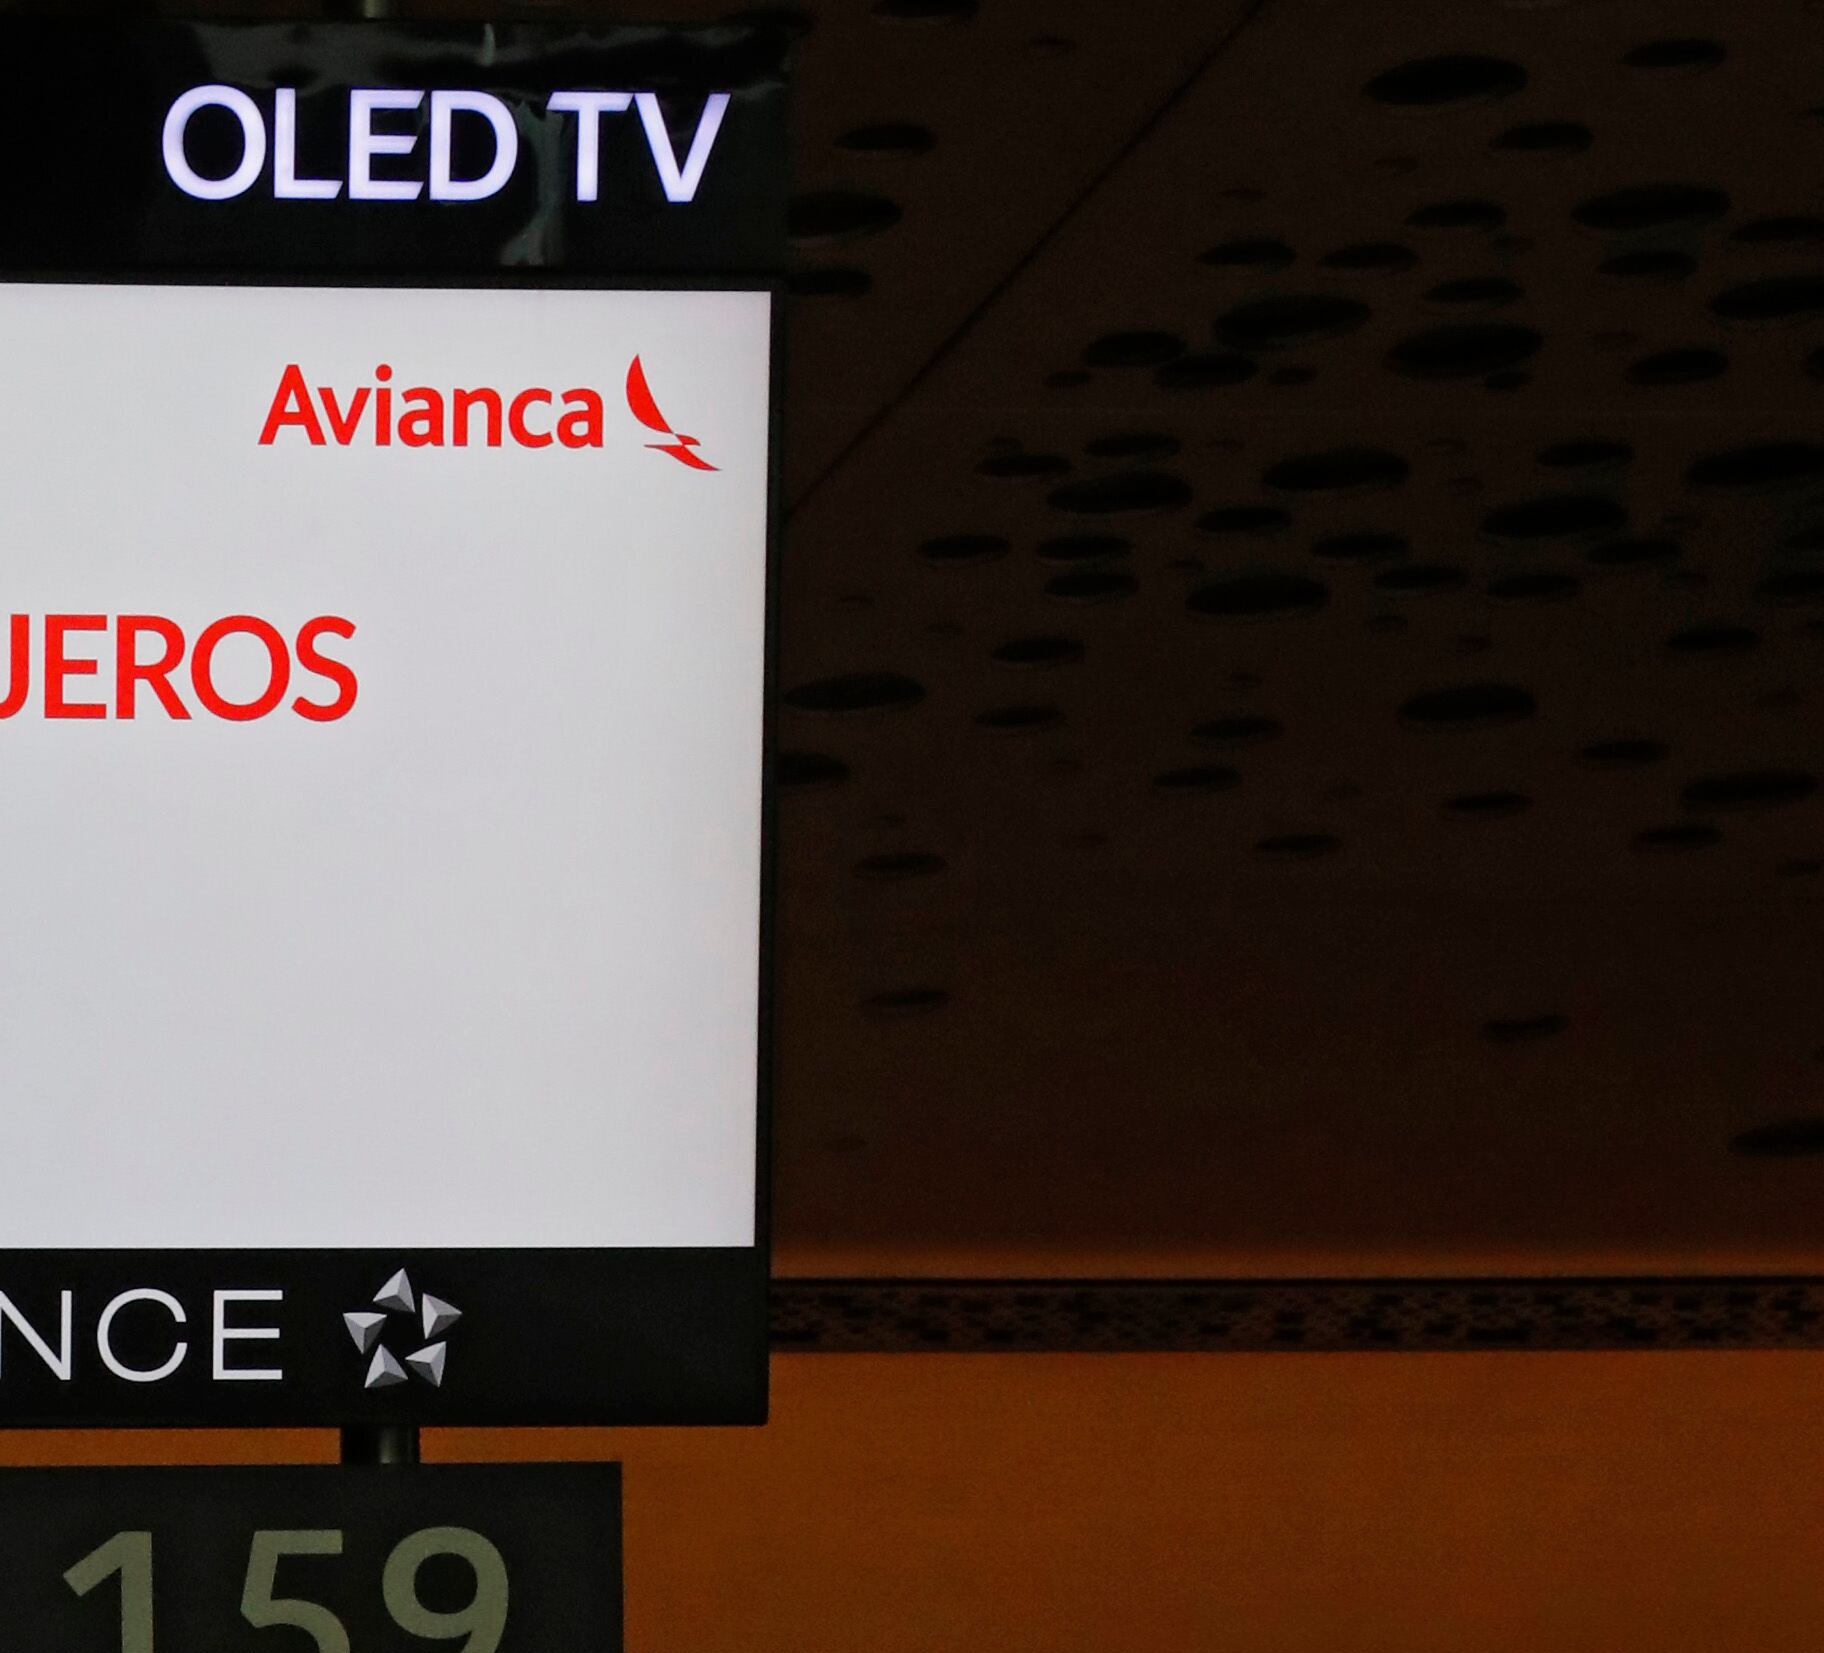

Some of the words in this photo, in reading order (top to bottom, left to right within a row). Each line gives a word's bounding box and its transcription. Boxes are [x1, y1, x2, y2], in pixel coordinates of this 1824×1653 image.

[161, 84, 519, 201] OLED
[546, 92, 731, 203] TV
[258, 364, 604, 448] Avianca
